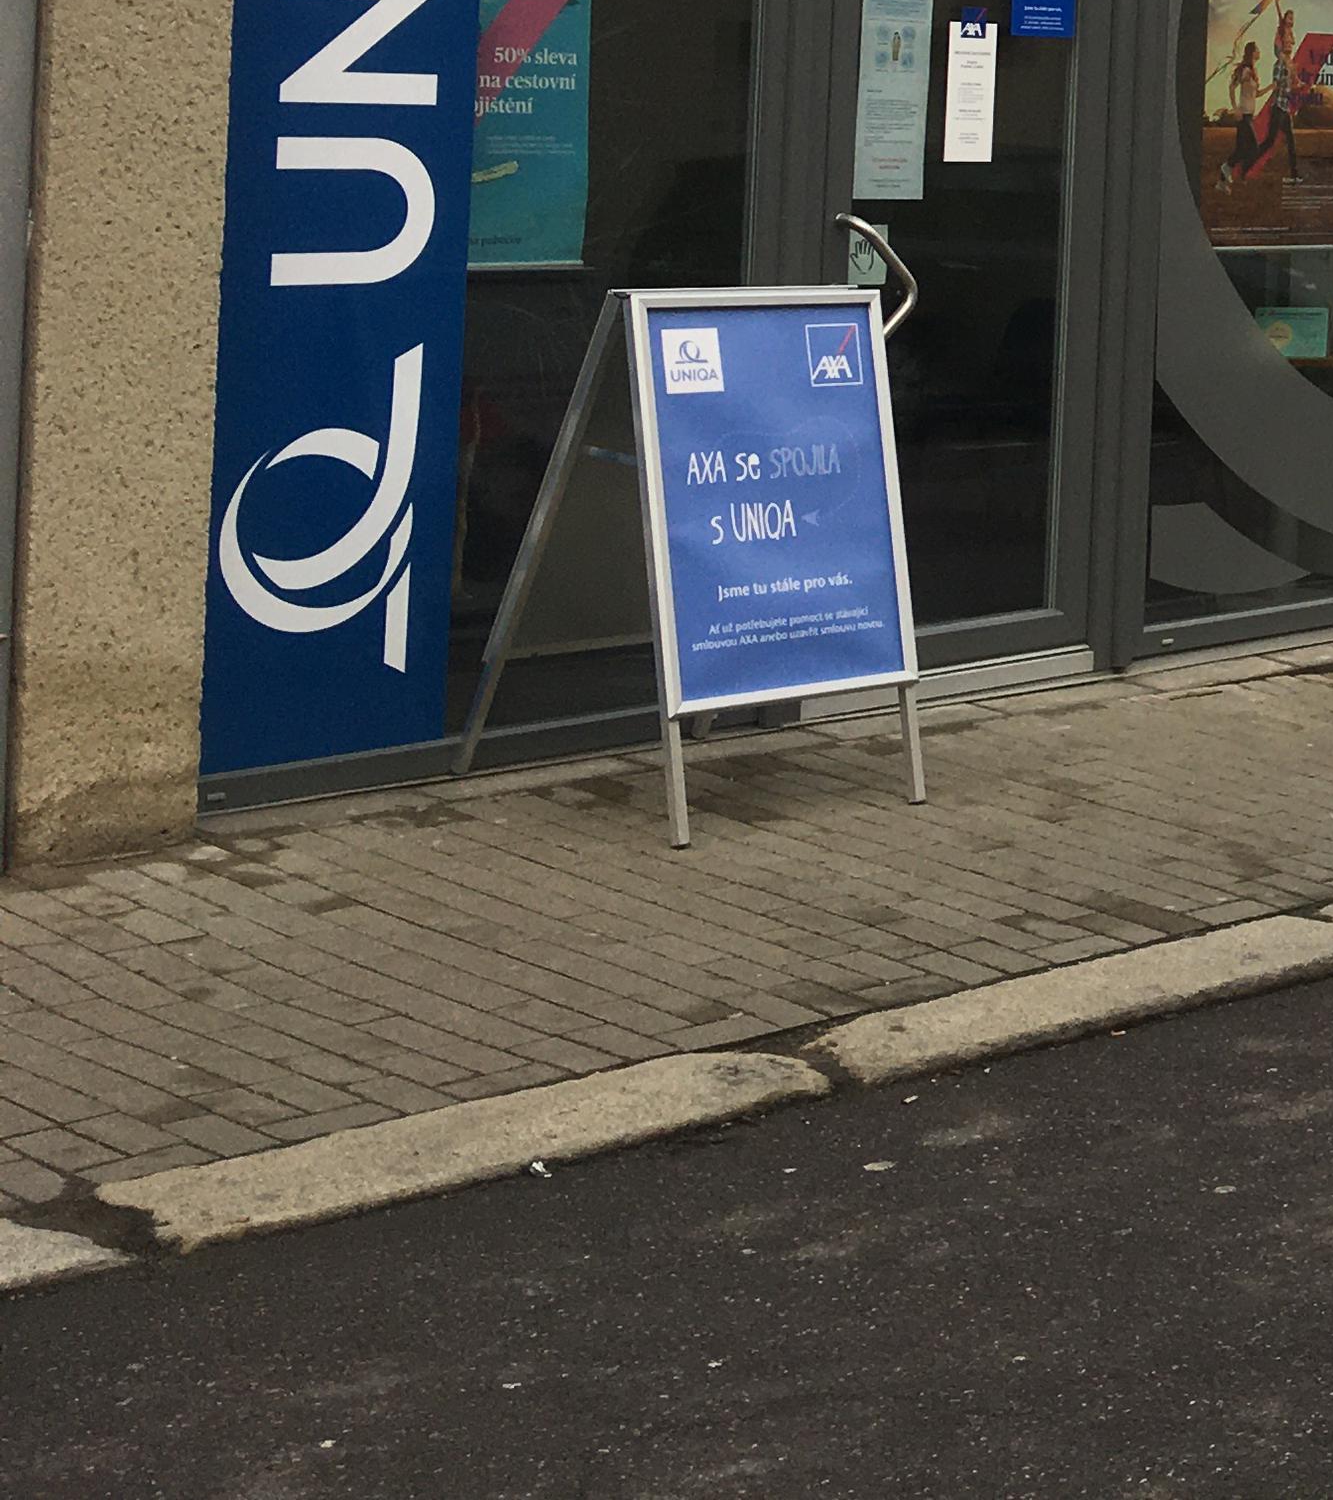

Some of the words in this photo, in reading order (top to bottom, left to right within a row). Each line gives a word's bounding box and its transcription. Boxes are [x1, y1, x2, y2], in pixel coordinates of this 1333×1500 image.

[494, 47, 532, 64] 50%
[535, 48, 577, 66] sleva
[480, 74, 501, 88] na
[505, 73, 577, 91] cestovní
[670, 368, 719, 383] UNIQA
[812, 355, 853, 381] AXA
[687, 451, 727, 485] AXA
[735, 452, 761, 482] se
[769, 444, 841, 479] SPOJILA
[710, 515, 724, 545] s
[730, 499, 797, 542] UNIQA
[718, 584, 750, 602] Jsme
[752, 583, 768, 595] tu
[770, 577, 801, 593] stále
[804, 578, 826, 593] pro
[828, 571, 853, 587] vás.
[691, 638, 738, 652] smlouvou
[739, 634, 759, 646] AXA
[759, 631, 788, 644] anebo
